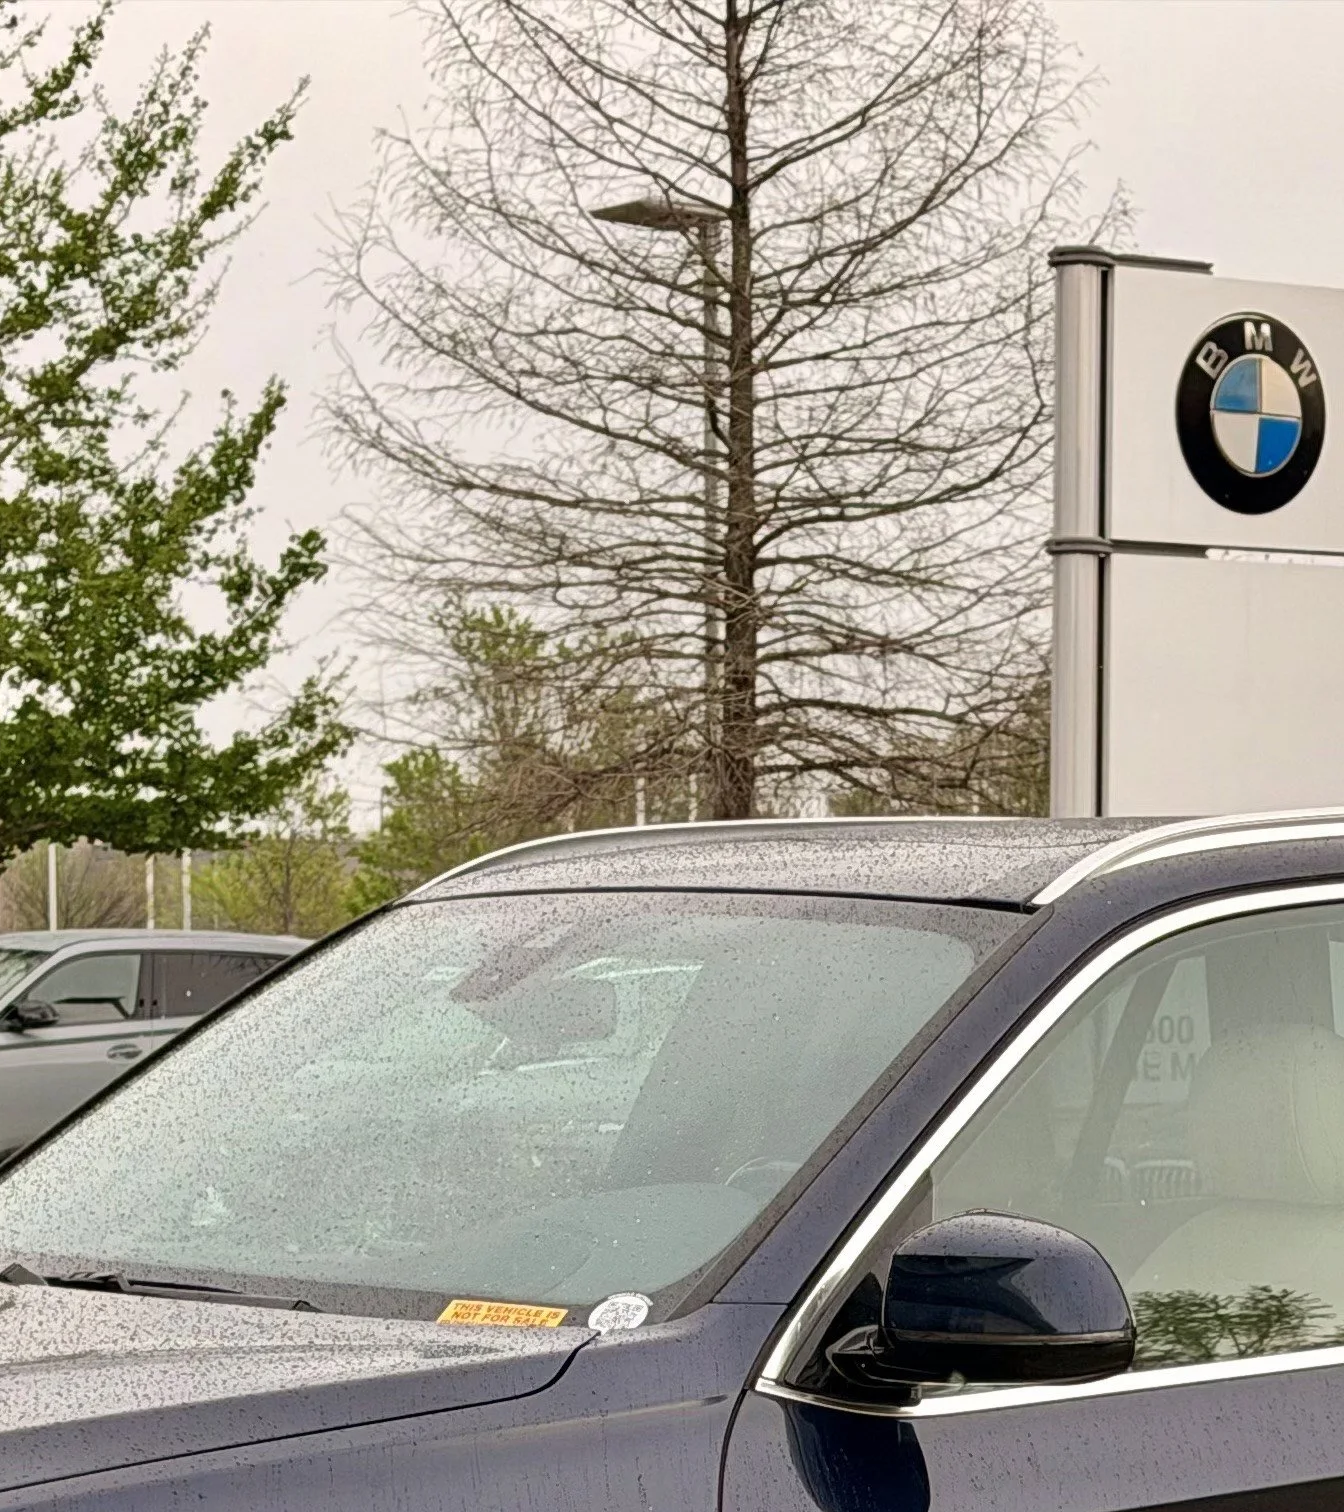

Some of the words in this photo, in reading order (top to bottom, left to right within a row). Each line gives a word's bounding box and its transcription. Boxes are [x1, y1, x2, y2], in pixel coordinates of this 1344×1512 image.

[1196, 321, 1318, 389] BMW
[451, 1311, 480, 1321] NOT
[480, 1313, 510, 1324] FOR
[453, 1302, 482, 1313] THIS
[486, 1305, 544, 1318] VEHICLE
[546, 1310, 561, 1320] IS
